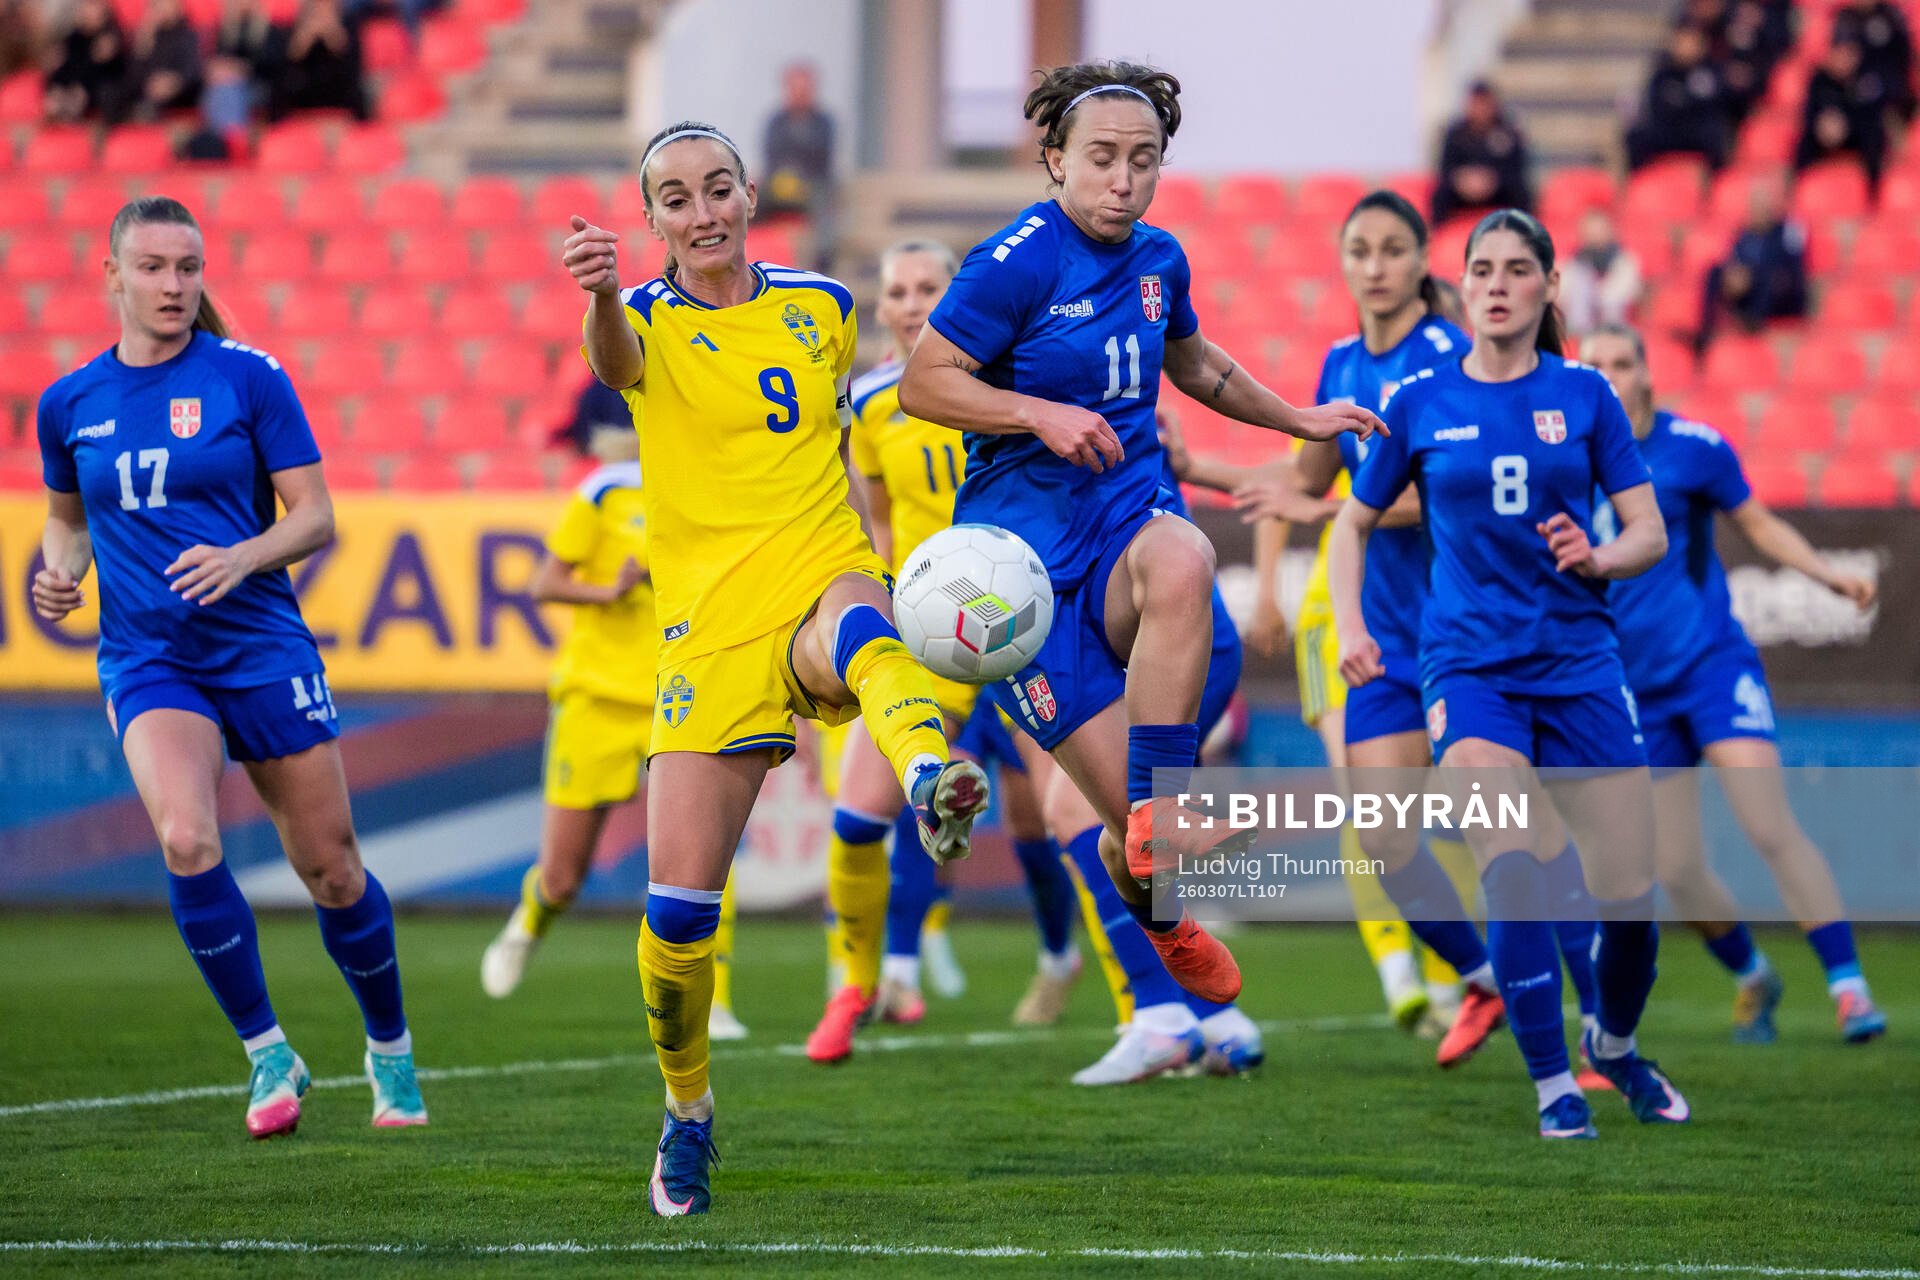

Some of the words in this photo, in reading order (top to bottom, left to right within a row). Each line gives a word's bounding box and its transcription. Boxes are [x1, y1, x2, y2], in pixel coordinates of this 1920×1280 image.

[1049, 299, 1094, 317] capelli
[1102, 334, 1141, 401] 11
[758, 367, 800, 433] 9
[115, 448, 170, 511] 17
[922, 444, 958, 493] 11
[1491, 454, 1529, 516] 8
